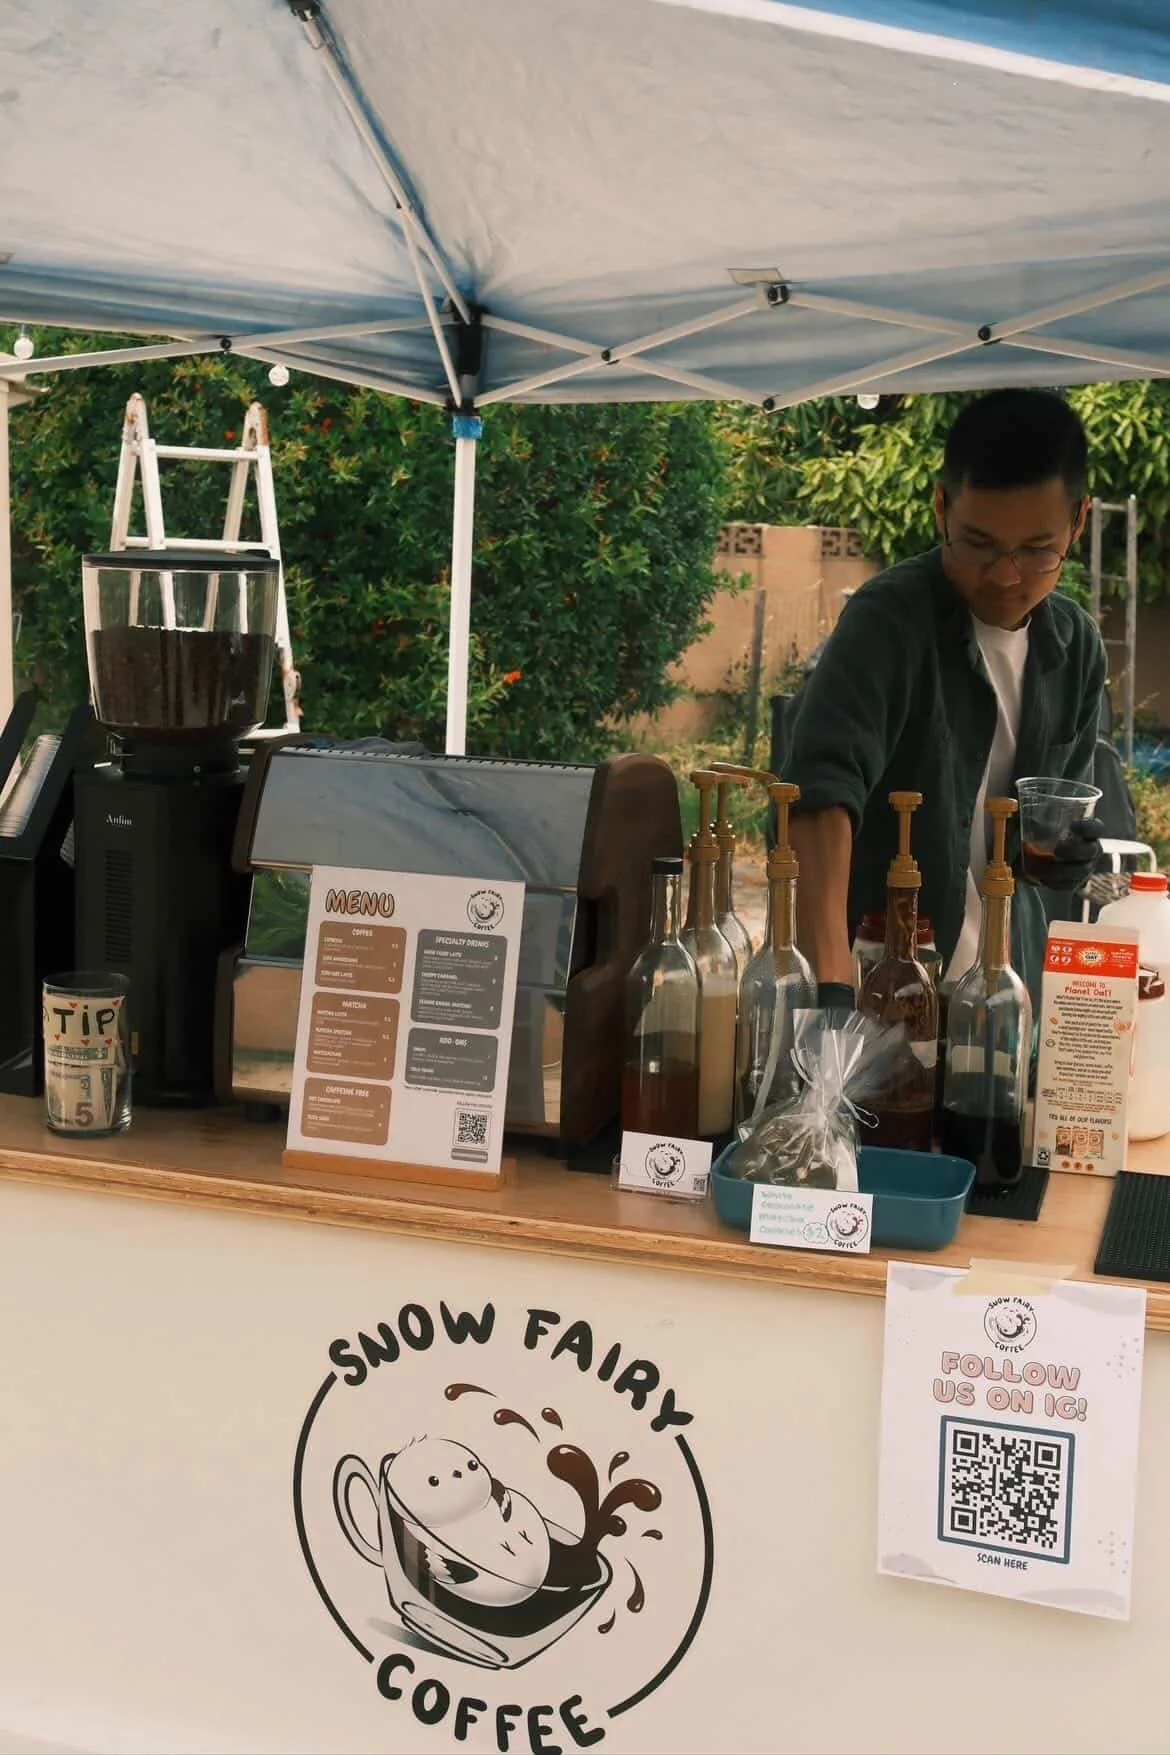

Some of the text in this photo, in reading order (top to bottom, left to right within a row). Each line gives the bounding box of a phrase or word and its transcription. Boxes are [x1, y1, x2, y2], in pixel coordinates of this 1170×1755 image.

[325, 888, 395, 918] MENU
[75, 1101, 93, 1127] 5
[988, 1297, 1034, 1312] SNOW FAIRY
[994, 1341, 1024, 1353] COFFEE
[329, 1300, 693, 1432] SNOW FAIRY
[941, 1350, 1081, 1391] FOLLOW
[932, 1378, 1088, 1422] US ON IG!
[976, 1552, 1028, 1570] SCAN HERE
[377, 1653, 605, 1755] COFFEE
